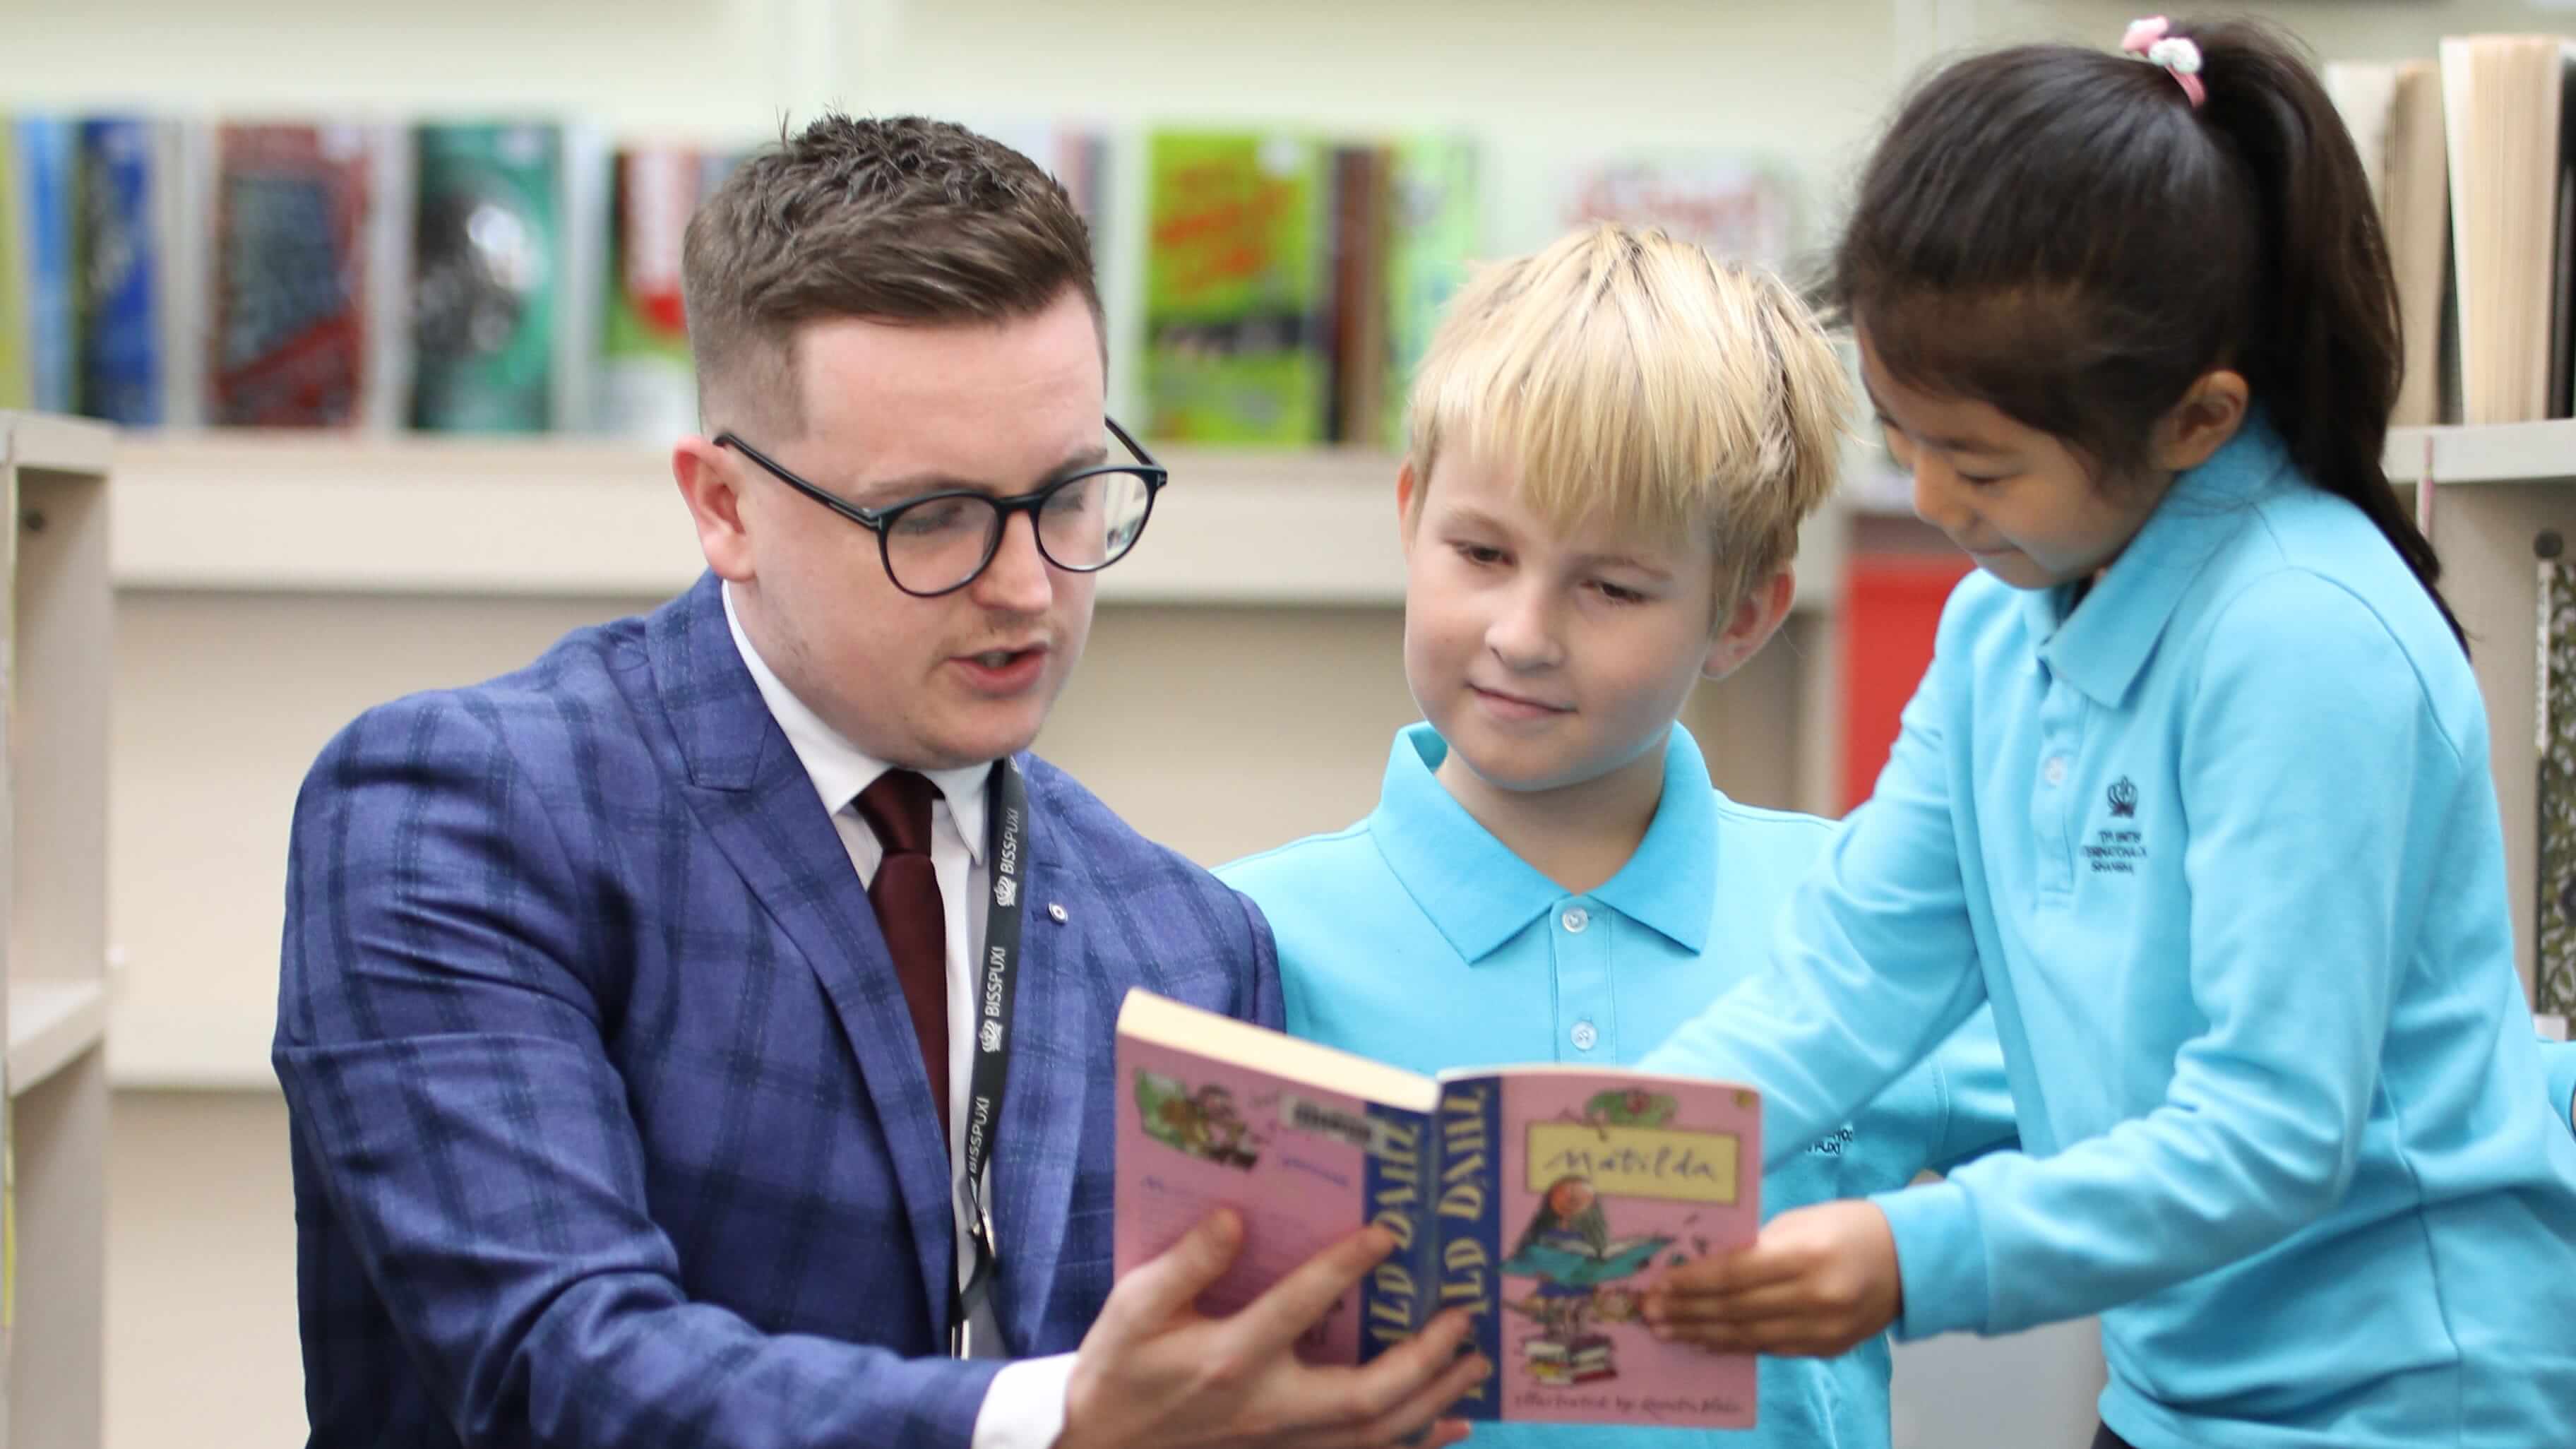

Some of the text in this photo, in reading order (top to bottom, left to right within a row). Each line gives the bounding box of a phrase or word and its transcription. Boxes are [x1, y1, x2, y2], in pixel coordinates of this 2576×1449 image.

[999, 807, 1019, 875] BISSPUXI
[984, 946, 1006, 1018] BISSPUXI
[968, 1096, 990, 1174] BISSPUXI
[1437, 1087, 1490, 1220] DAHL
[1542, 1145, 1718, 1183] Matilda
